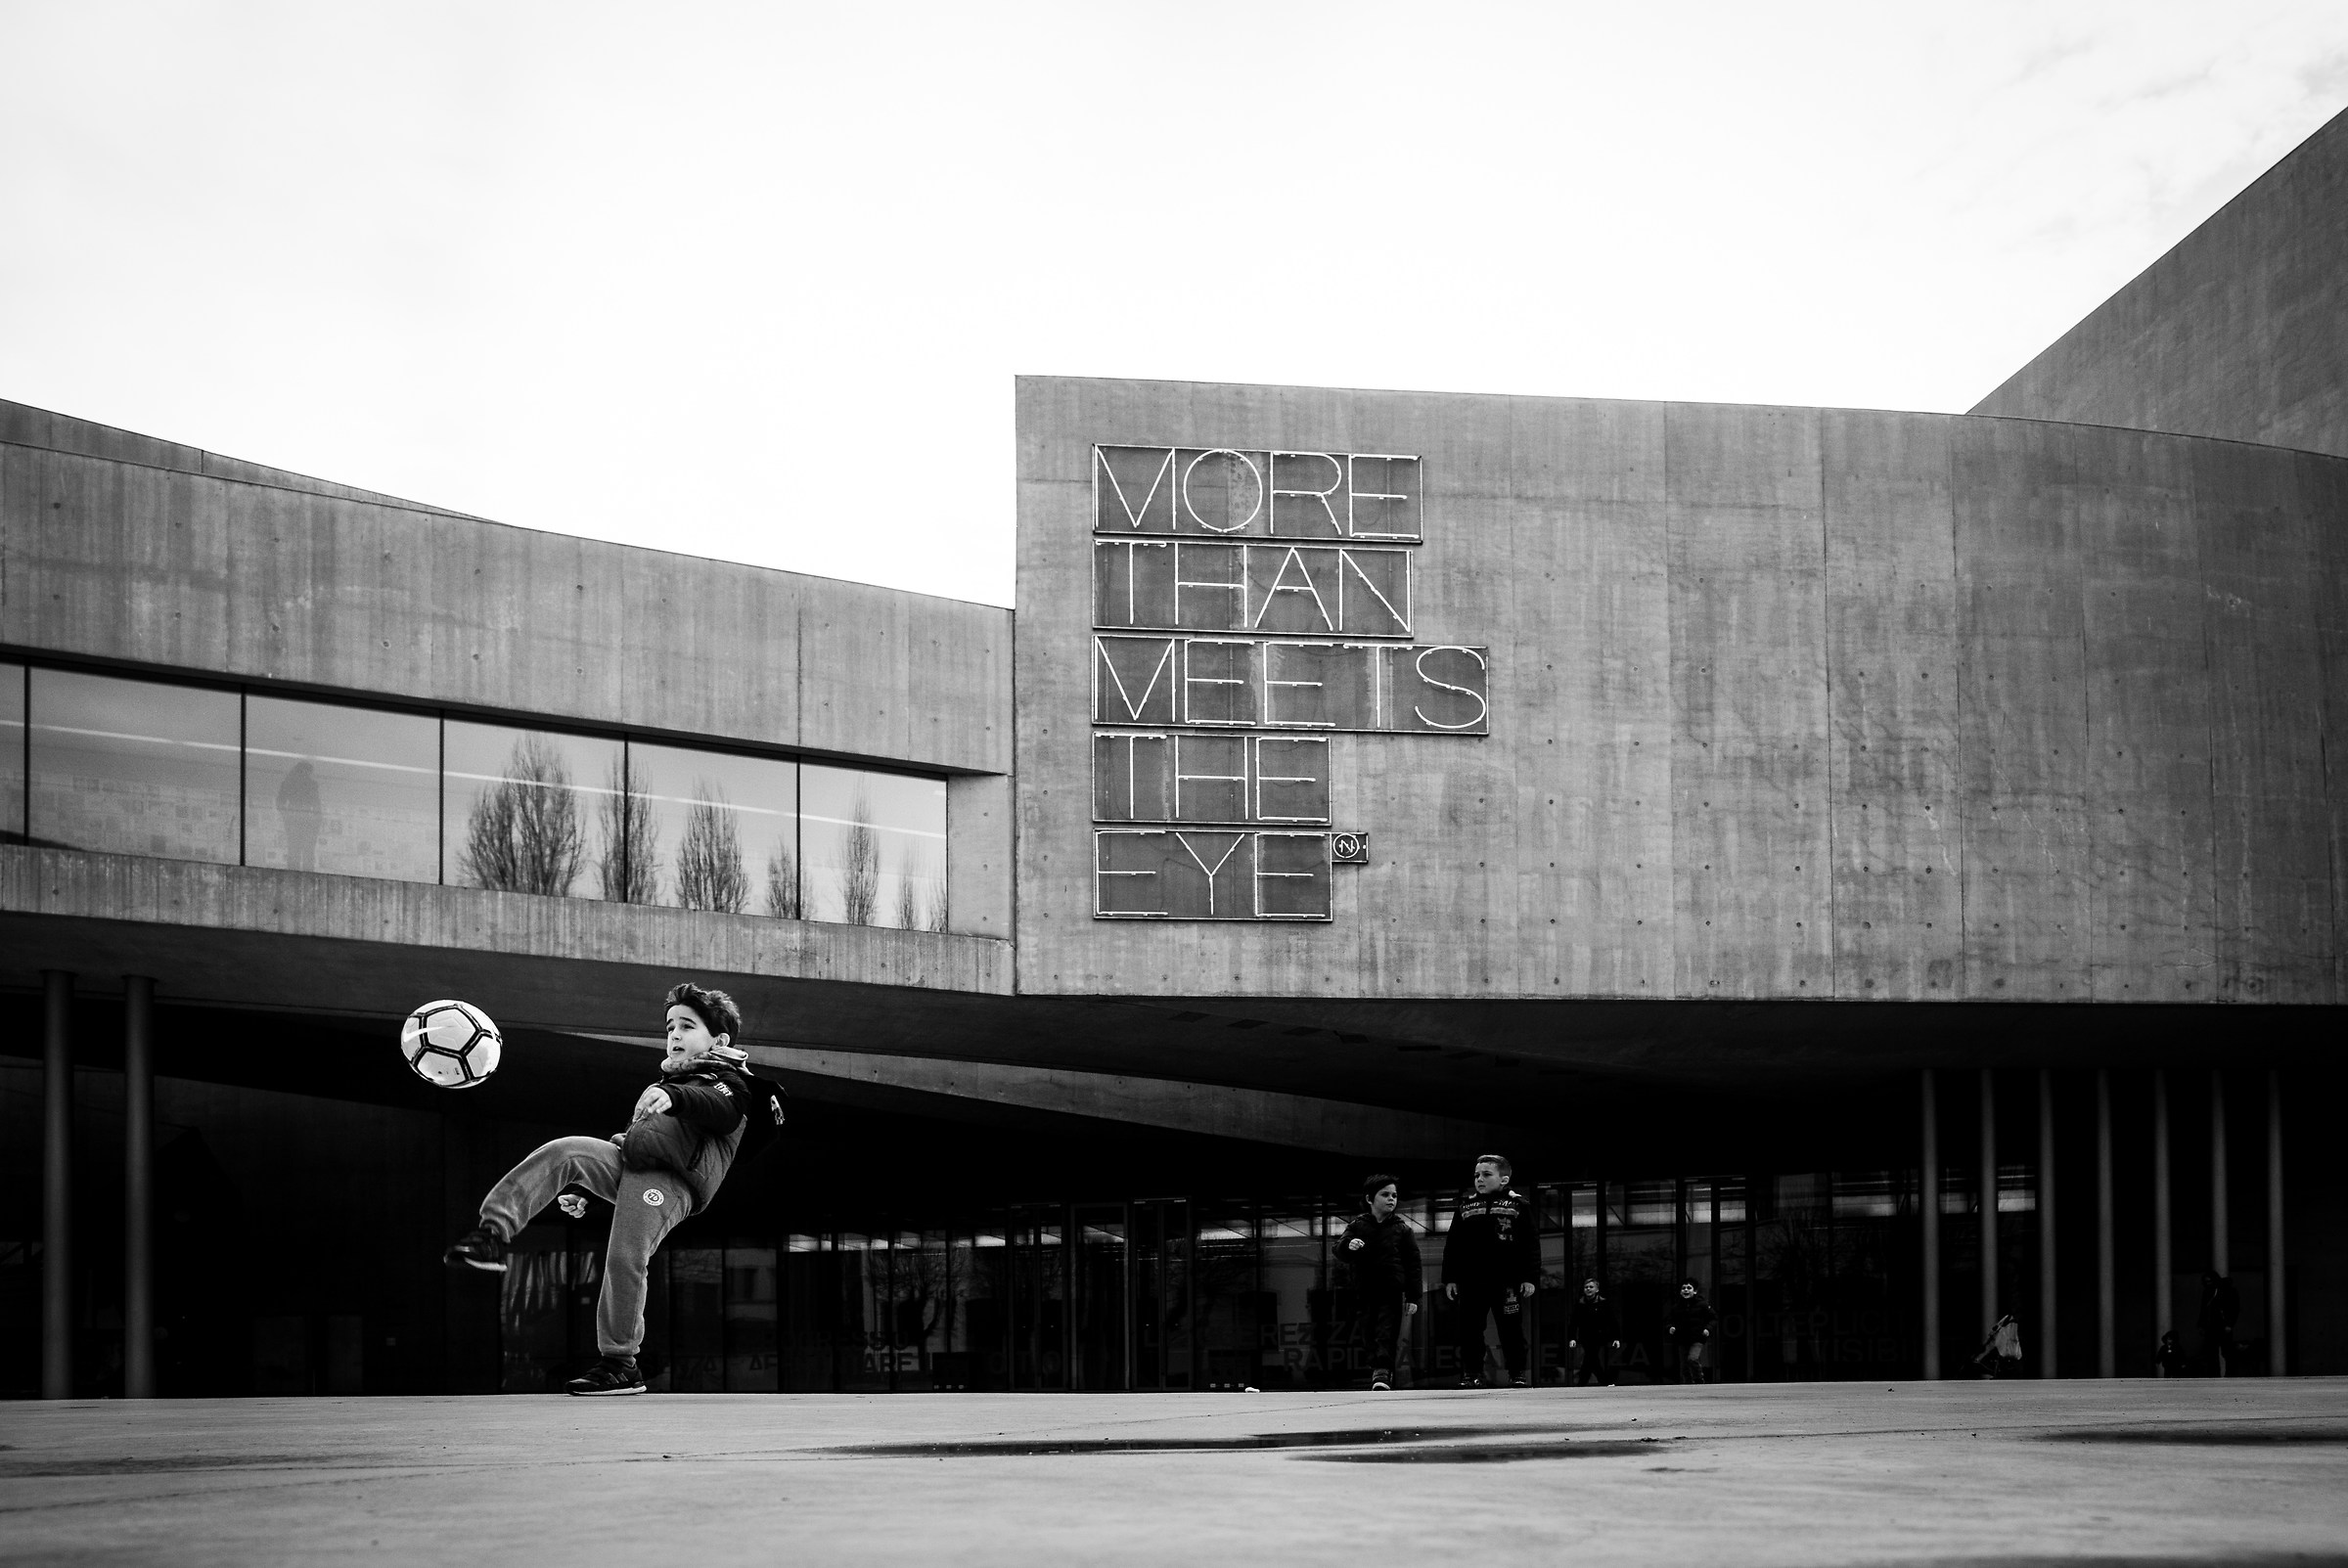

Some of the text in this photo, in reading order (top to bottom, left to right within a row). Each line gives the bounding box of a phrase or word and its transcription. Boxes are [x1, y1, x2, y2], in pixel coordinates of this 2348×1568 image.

[1094, 446, 1420, 539] MORE
[1095, 541, 1412, 633] THAN
[1094, 636, 1487, 729] MEETS
[1095, 734, 1328, 822] THE
[1095, 830, 1327, 918] EYE
